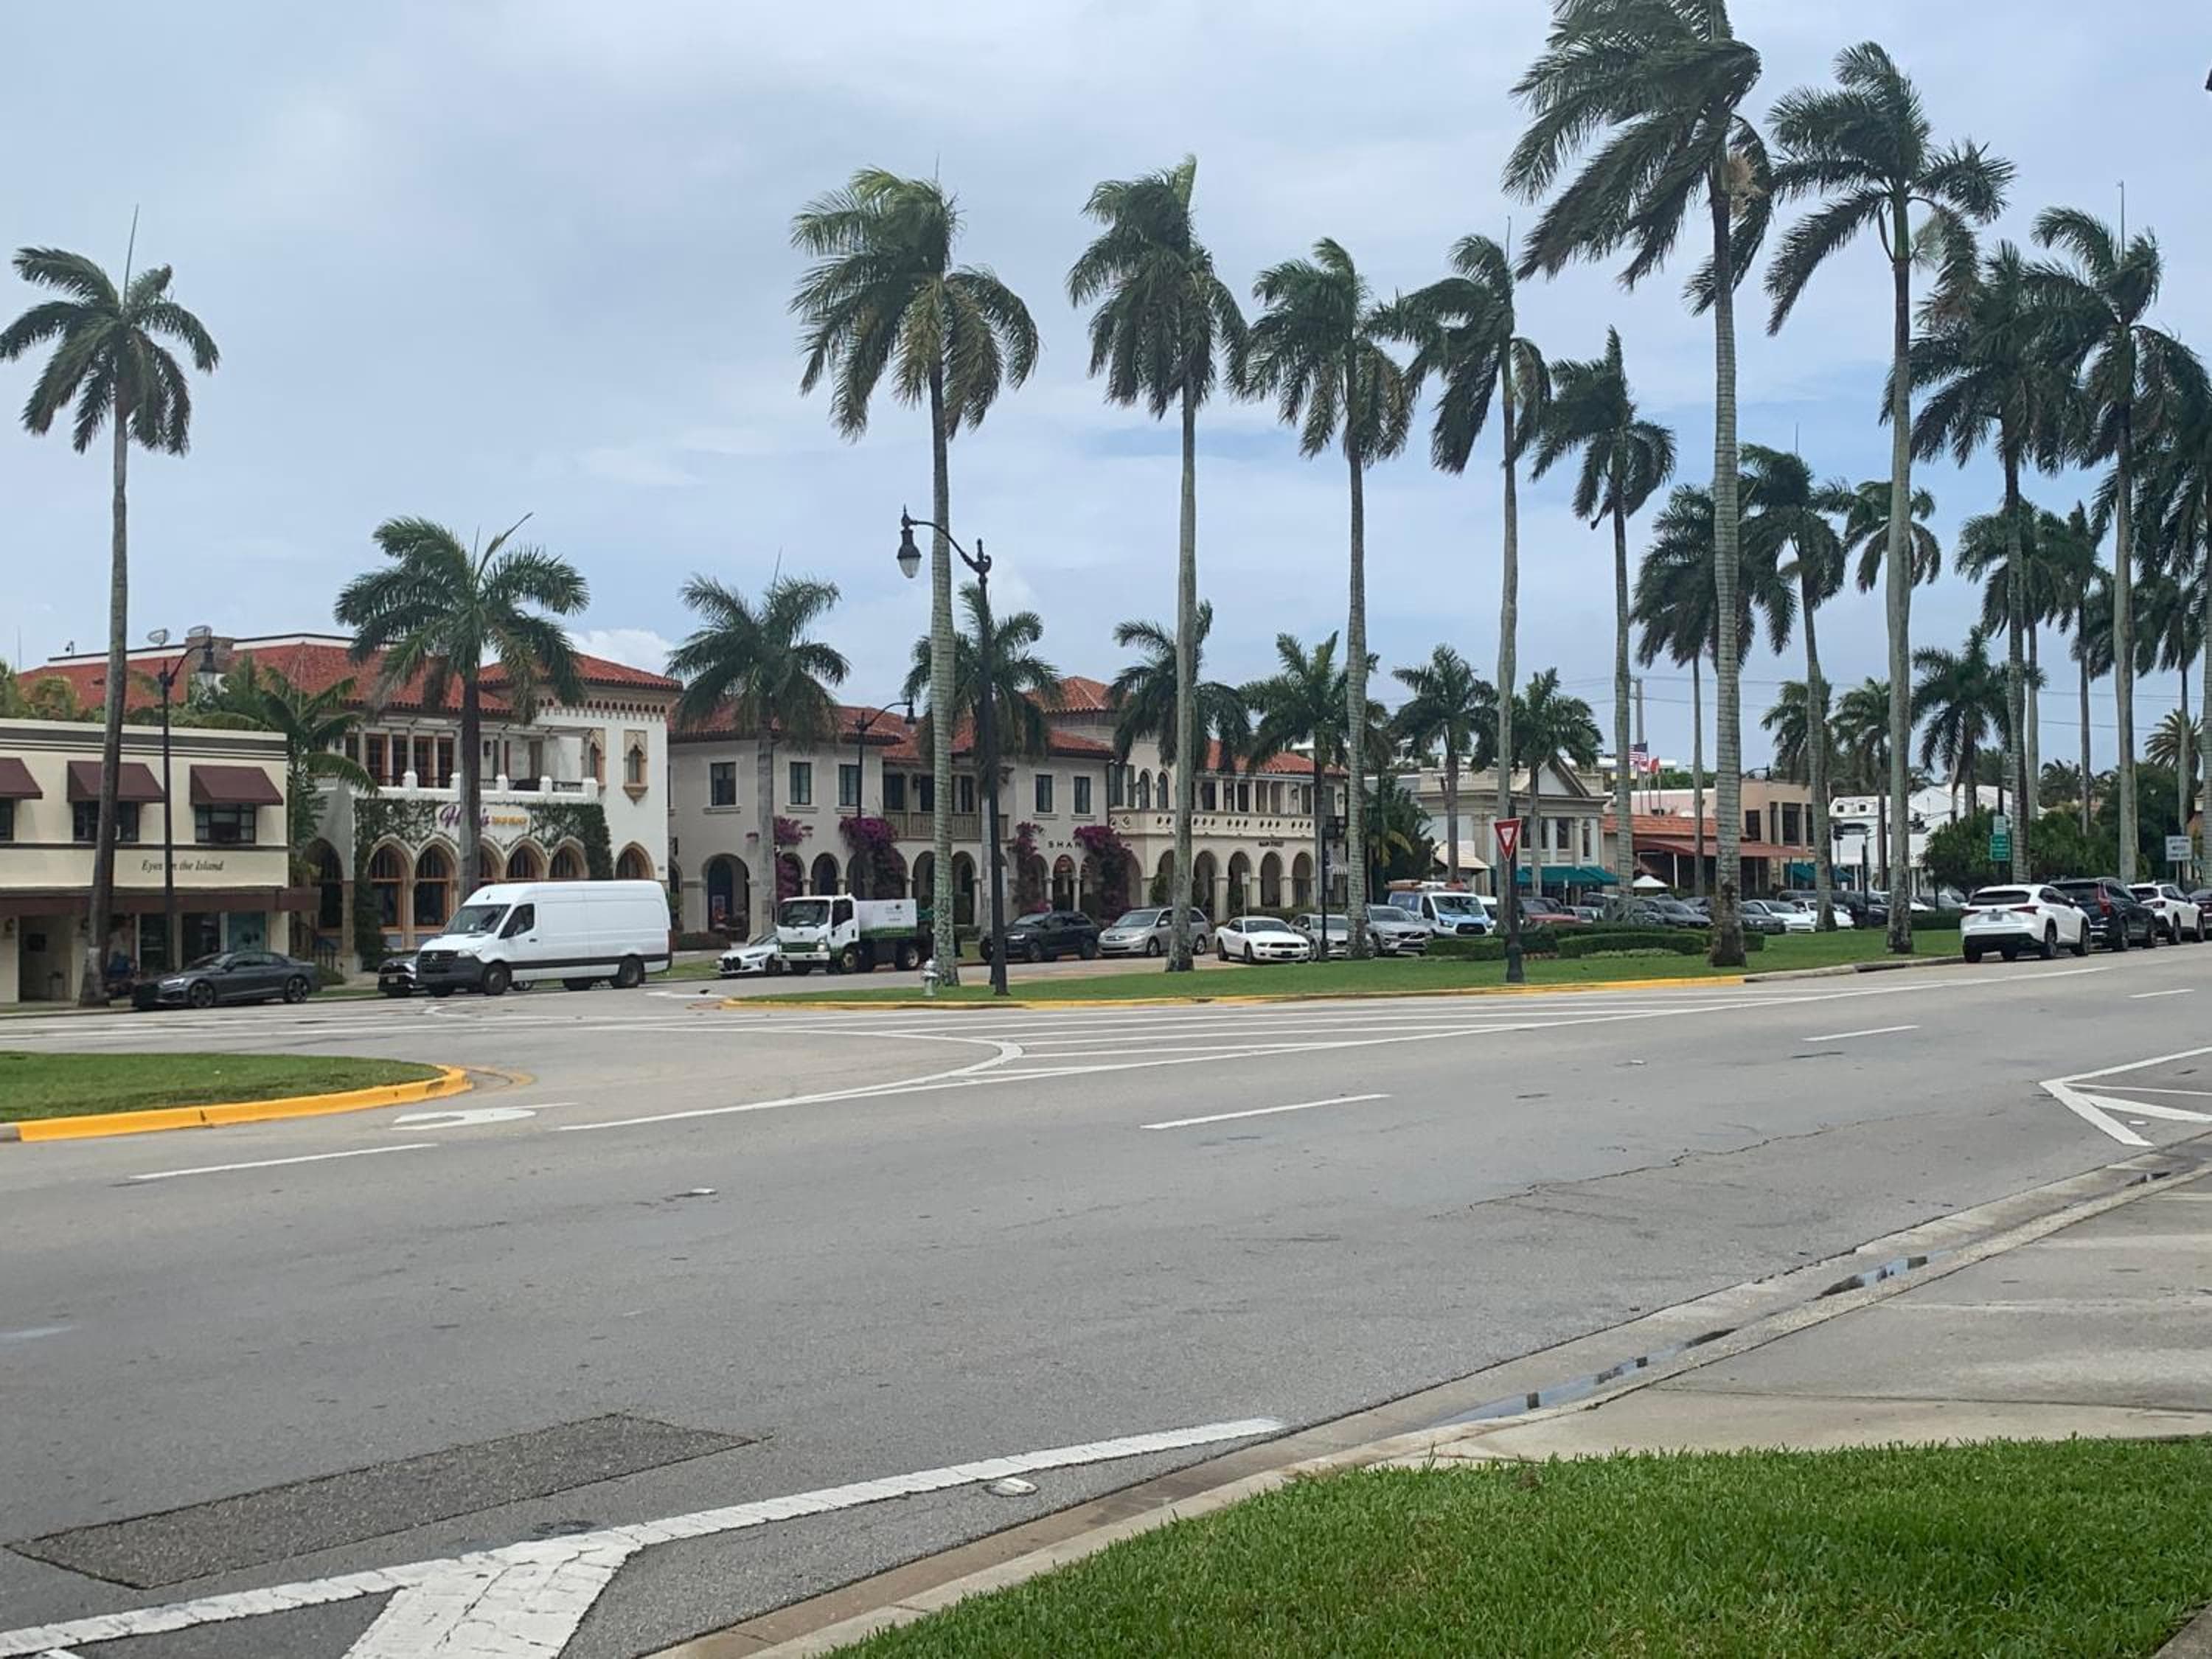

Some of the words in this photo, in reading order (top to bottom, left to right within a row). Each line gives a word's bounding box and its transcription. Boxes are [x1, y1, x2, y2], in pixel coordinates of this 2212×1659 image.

[142, 859, 163, 873] Eyes
[179, 859, 193, 871] the
[195, 860, 224, 871] Island
